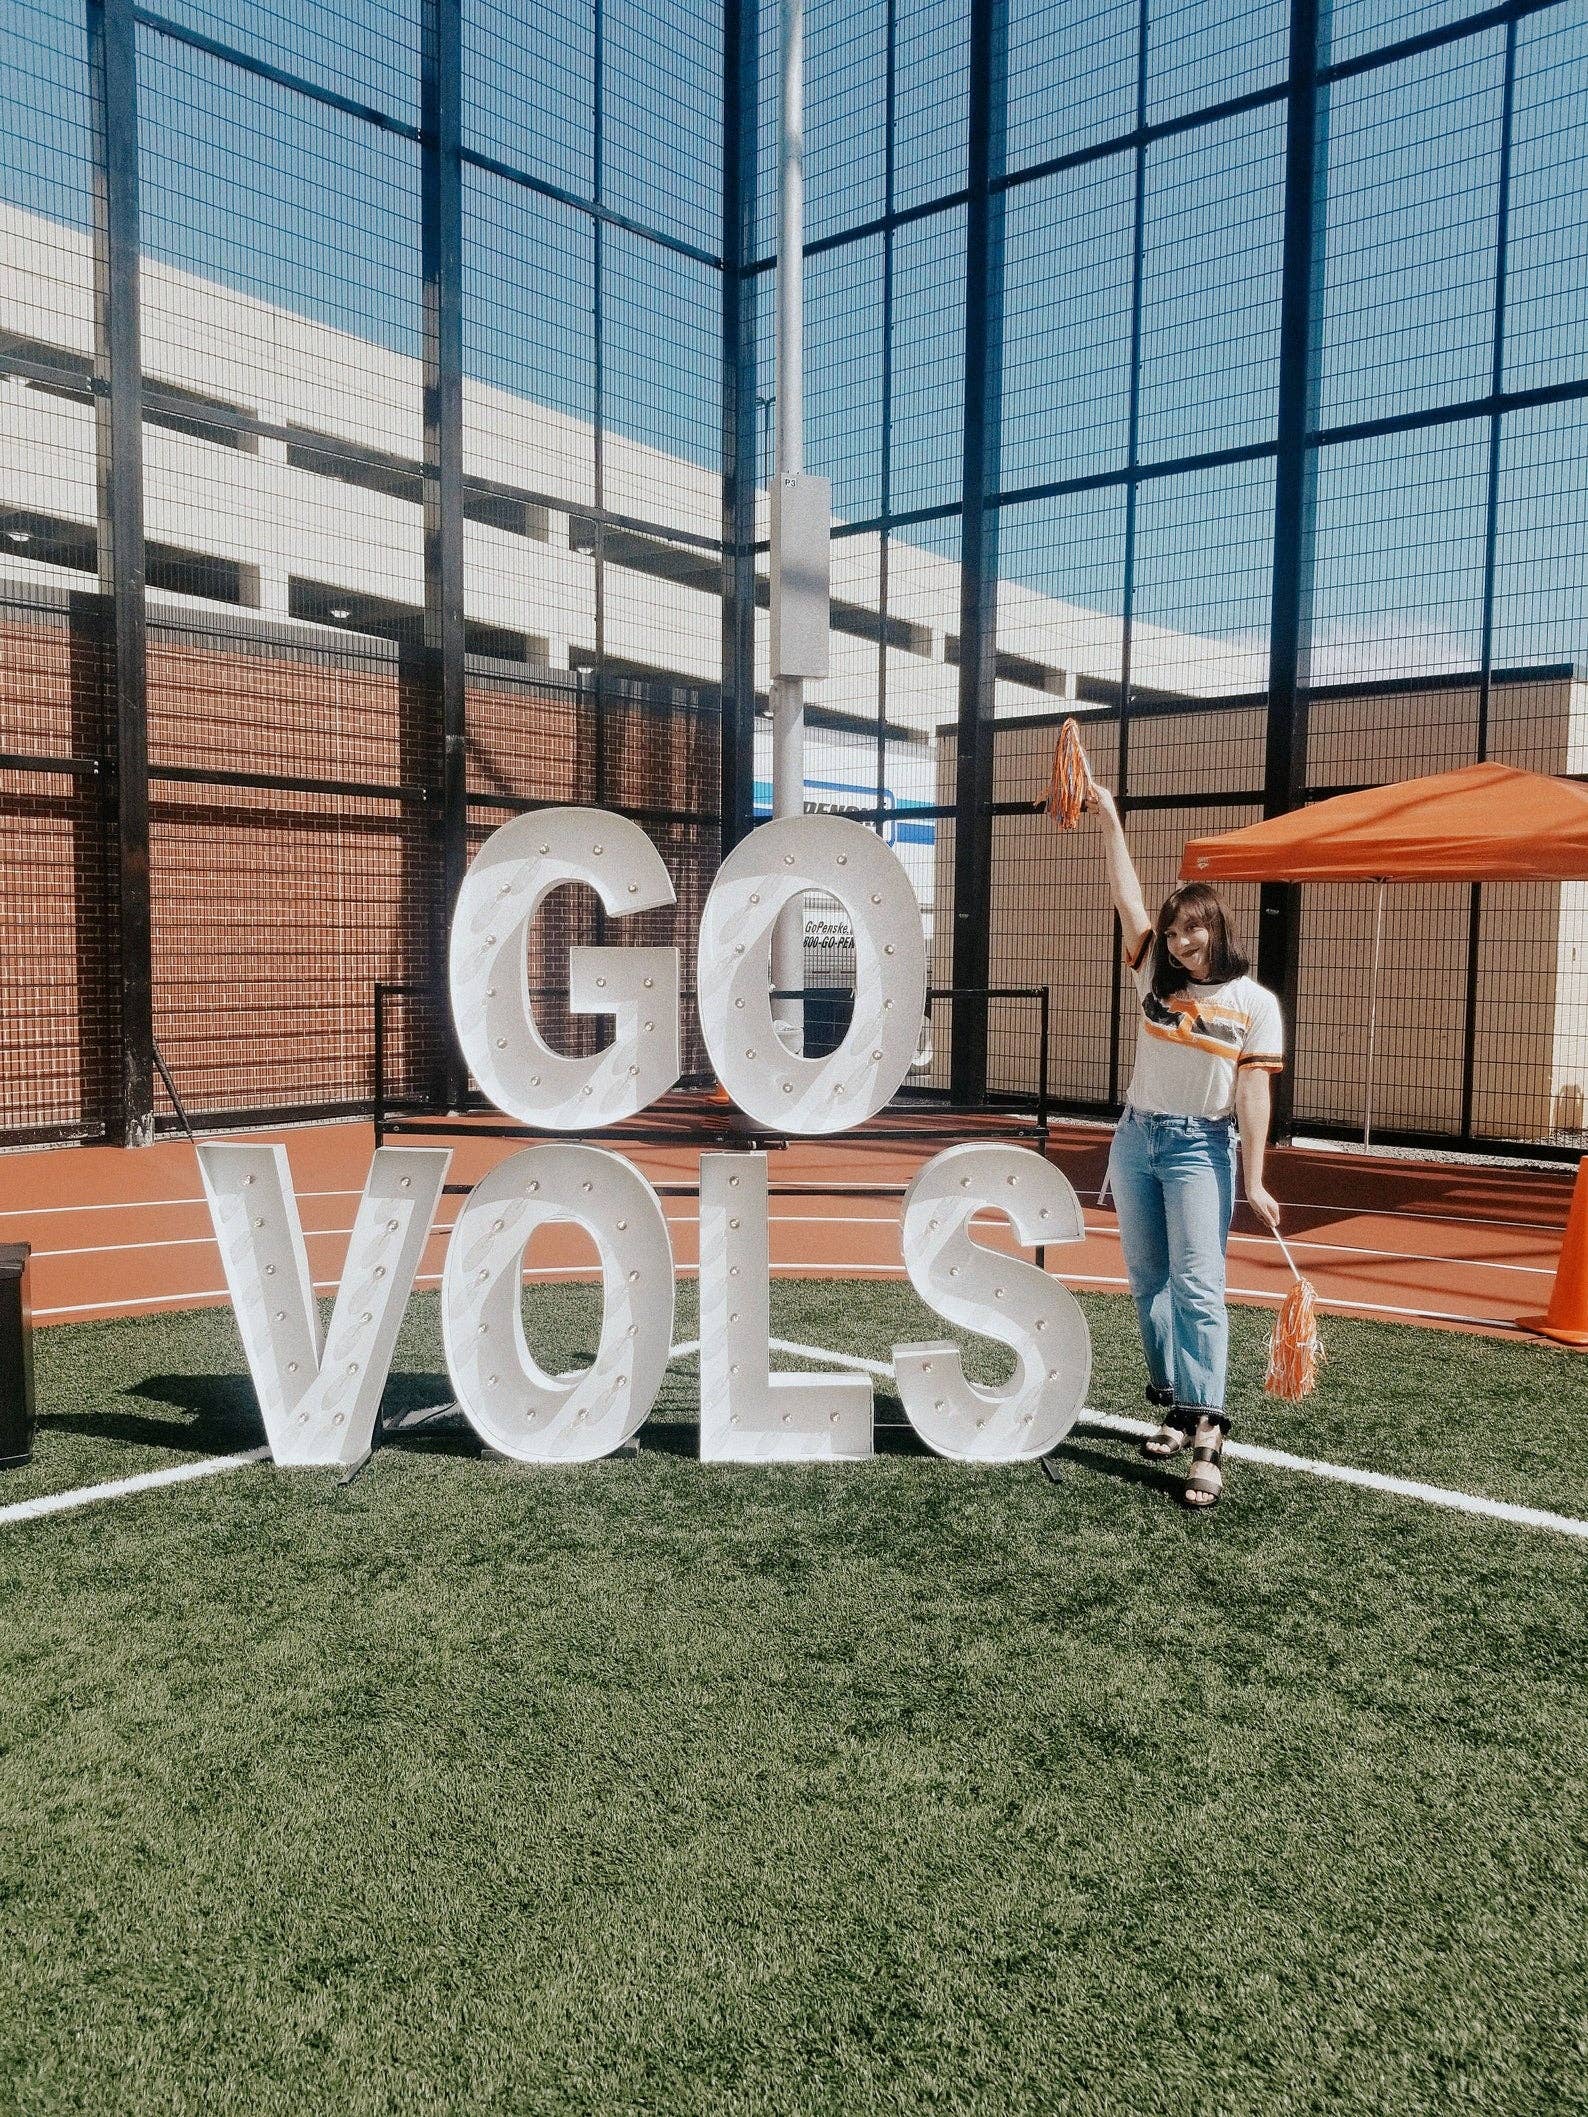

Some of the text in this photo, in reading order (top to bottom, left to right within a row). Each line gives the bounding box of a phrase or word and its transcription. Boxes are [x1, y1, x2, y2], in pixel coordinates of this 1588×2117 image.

[449, 807, 927, 1134] GO
[803, 936, 855, 949] 800-GO-PEN
[805, 920, 852, 934] GoPenske.
[196, 1142, 1092, 1466] VOLS
